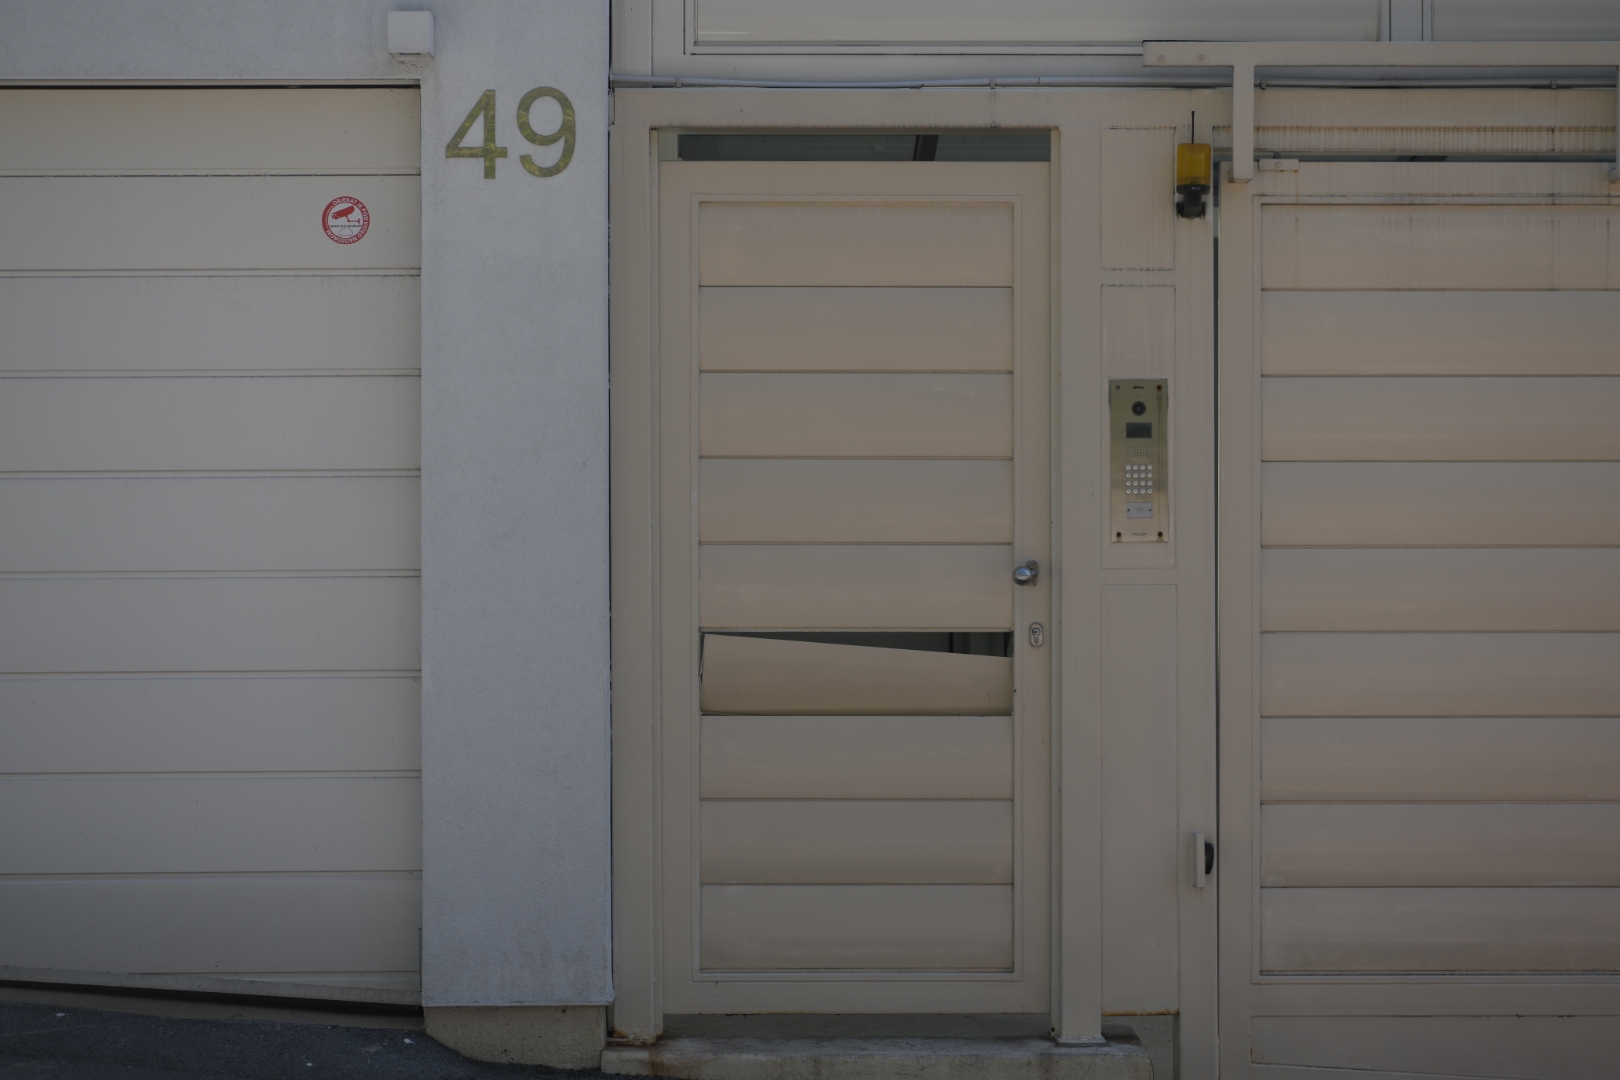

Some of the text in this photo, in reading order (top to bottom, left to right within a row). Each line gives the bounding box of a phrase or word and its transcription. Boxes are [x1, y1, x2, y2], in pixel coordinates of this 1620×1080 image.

[446, 86, 576, 179] 49
[326, 230, 358, 243] NADZOROM
[358, 222, 368, 238] VIDEO
